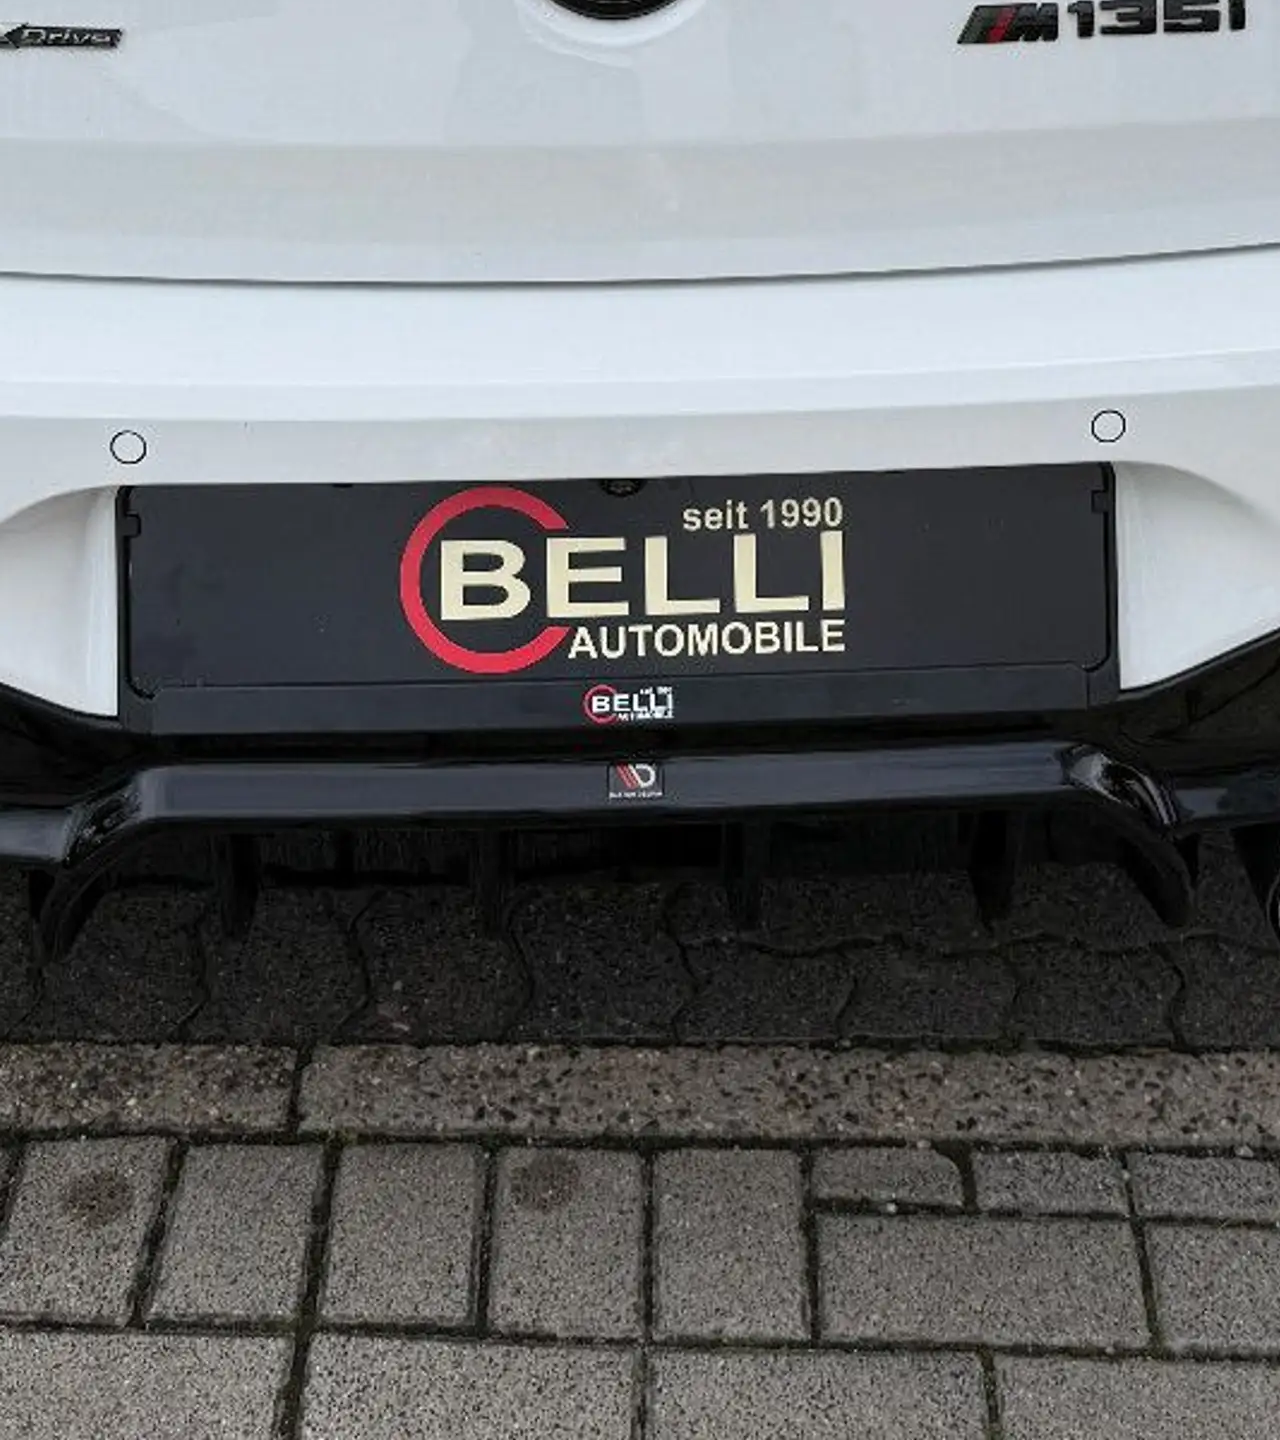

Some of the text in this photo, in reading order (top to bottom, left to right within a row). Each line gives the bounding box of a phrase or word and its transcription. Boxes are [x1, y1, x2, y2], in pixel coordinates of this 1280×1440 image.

[683, 497, 844, 532] seit 1990
[439, 531, 846, 621] BELLI
[568, 619, 846, 660] AUTOMOBILE
[591, 692, 674, 714] BELLI
